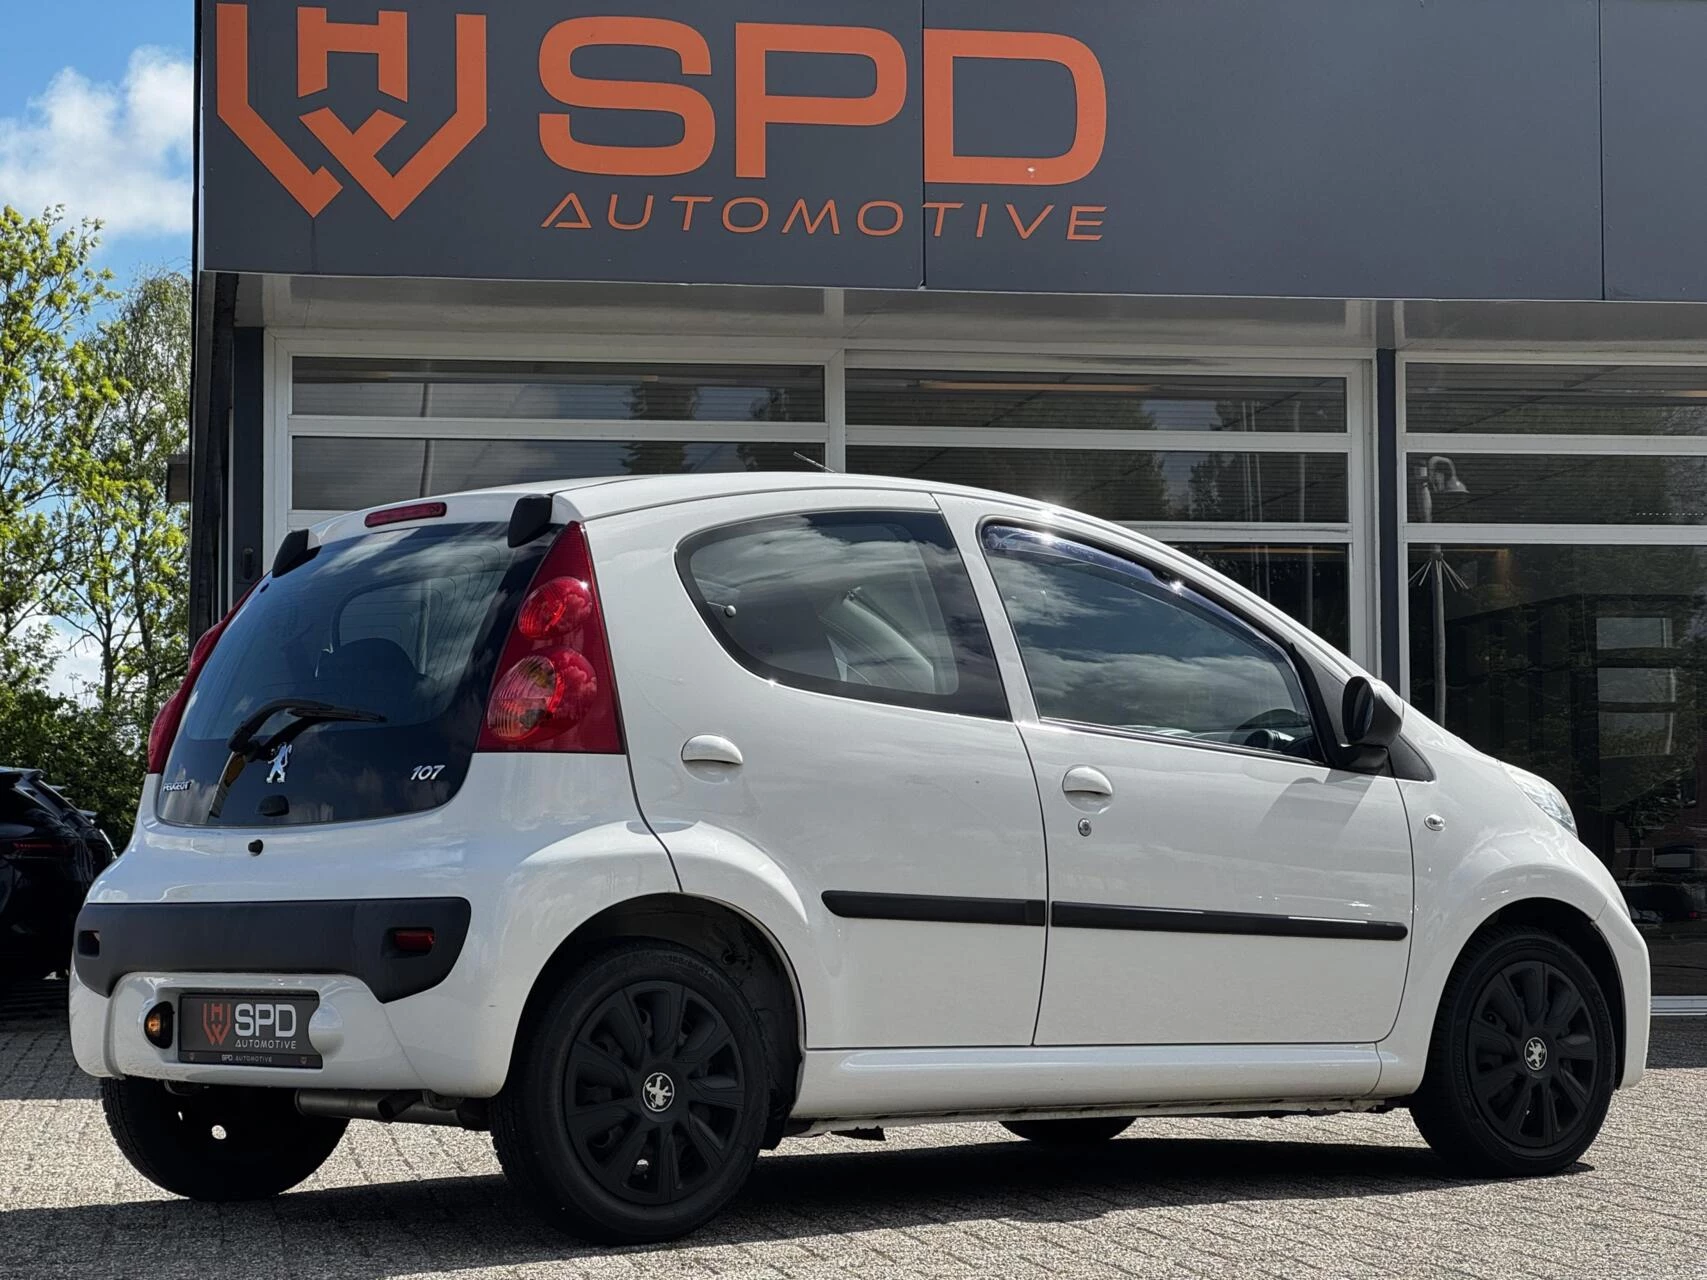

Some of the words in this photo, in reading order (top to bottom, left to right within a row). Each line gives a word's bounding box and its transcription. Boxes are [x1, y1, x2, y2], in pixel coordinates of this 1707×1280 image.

[538, 16, 1107, 186] SPD
[541, 192, 1107, 241] AUTOMOTIVE
[410, 764, 446, 781] 107
[235, 1003, 297, 1037] SPD
[235, 1040, 297, 1049] AUTOMOTIVE
[221, 1054, 233, 1062] SPD
[235, 1055, 273, 1063] AUTOMOTIVE
